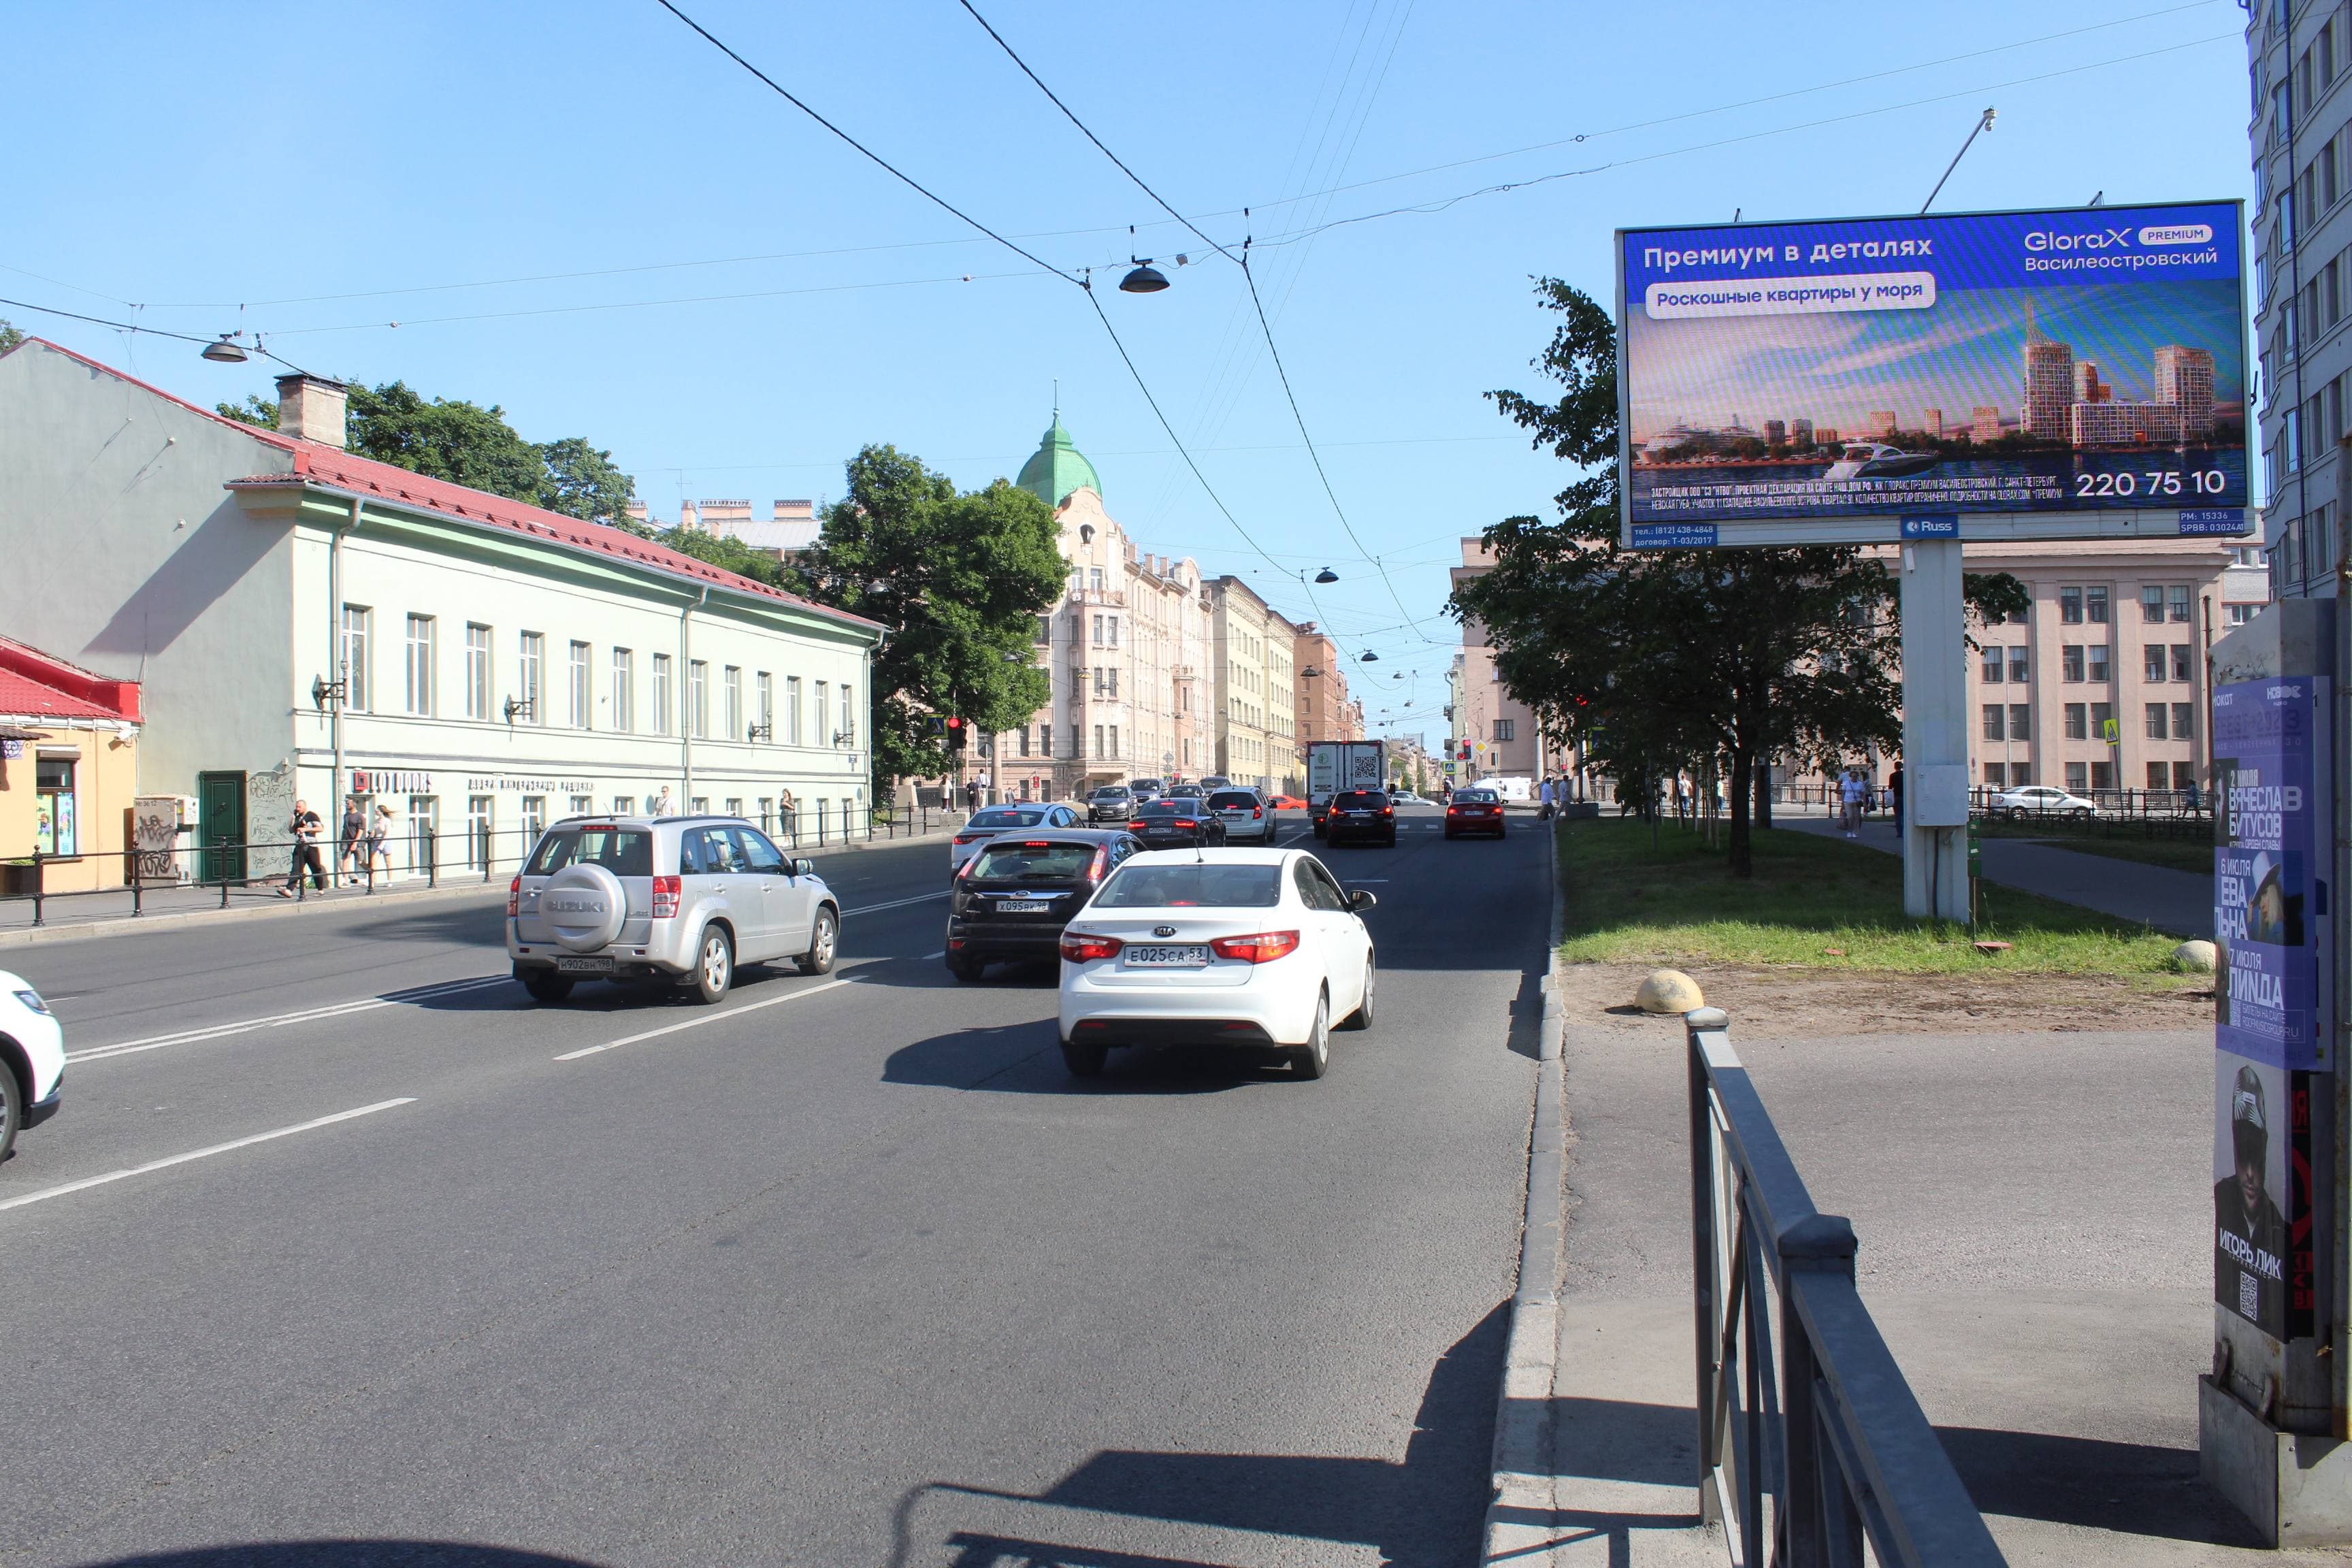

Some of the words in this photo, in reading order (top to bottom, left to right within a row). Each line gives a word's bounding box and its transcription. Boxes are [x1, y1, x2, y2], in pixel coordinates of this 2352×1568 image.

[2025, 228, 2132, 251] GloraX
[2148, 229, 2204, 240] PREMIUM
[1644, 247, 1773, 273] Премиум
[1785, 246, 1799, 261] в
[1810, 240, 1932, 264] деталях
[2025, 248, 2217, 271] Василеостровский
[1657, 291, 1761, 306] Роскошные
[1767, 287, 1855, 306] квартиры
[1860, 287, 1871, 301] у
[1876, 284, 1923, 303] моря
[1651, 485, 1688, 497] ЗАСТРОЙЩИК
[1735, 484, 1767, 495] ПРОЕКТНАЯ
[1807, 483, 1814, 493] НА
[1815, 480, 1833, 493] САЙТЕ
[1874, 480, 1883, 491] ЖК
[1911, 478, 1938, 490] ПРЕМИУМ
[2076, 473, 2136, 496] 220
[2146, 472, 2181, 495] 75
[2191, 470, 2225, 494] 10
[1651, 499, 1675, 510] НЕВСКАЯ
[1889, 492, 1914, 503] КВАРТИР
[1989, 490, 1996, 500] НА
[1921, 521, 1952, 531] Russ
[2202, 512, 2227, 520] 15336
[1656, 526, 1675, 535] (812)
[1677, 525, 1714, 534] 438-4848
[1671, 536, 1712, 545] Т-03/2017
[2230, 770, 2235, 787] 2
[2237, 769, 2258, 787] ИЮЛЯ
[2229, 786, 2302, 811] ВЯЧЕСЛАВ
[2229, 813, 2282, 838] БУТУСОВ
[2245, 838, 2261, 850] ОРДЕН
[2261, 840, 2281, 851] СЛАВЫ
[2221, 858, 2225, 875] 6
[2227, 859, 2251, 877] ИЮЛЯ
[2221, 876, 2248, 908] ЕВА
[549, 901, 604, 913] SUZUKI
[1156, 928, 1173, 936] KIA
[2230, 949, 2234, 965] 7
[2236, 949, 2261, 970] ИЮЛЯ
[2242, 1003, 2261, 1017] БИЛЕТЫ
[2261, 1009, 2268, 1019] НА
[2269, 1009, 2285, 1024] САЙТЕ
[2220, 1227, 2254, 1264] ИГОРЬ
[2256, 1247, 2282, 1280] ЛИК
